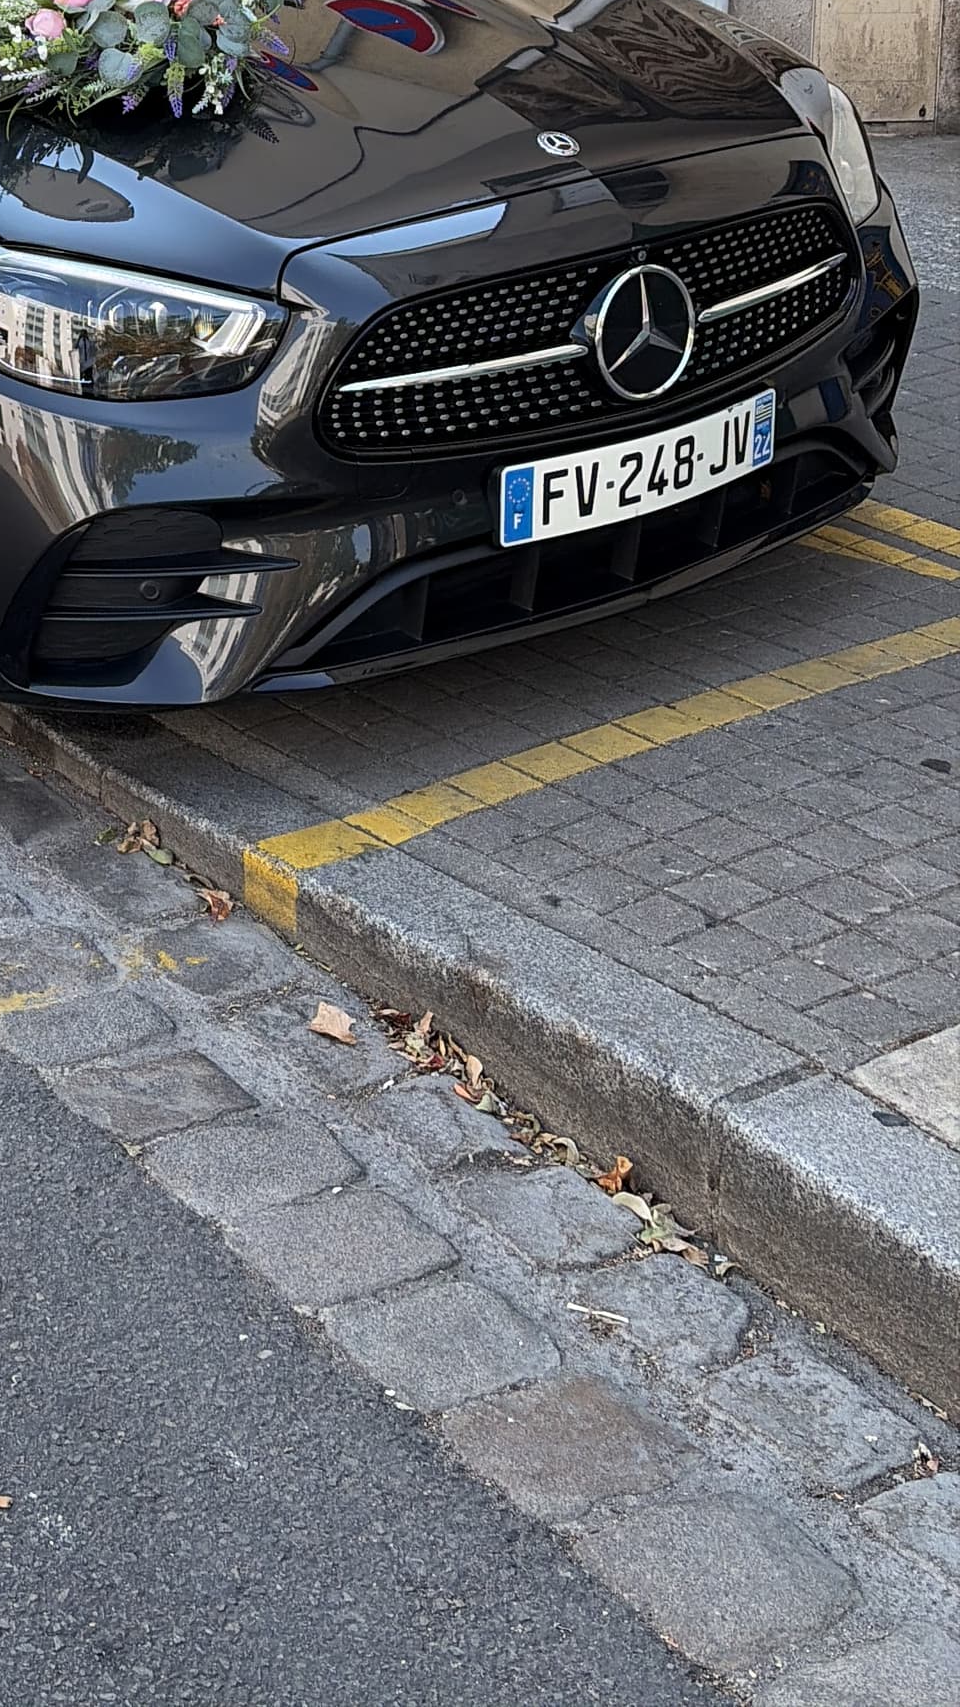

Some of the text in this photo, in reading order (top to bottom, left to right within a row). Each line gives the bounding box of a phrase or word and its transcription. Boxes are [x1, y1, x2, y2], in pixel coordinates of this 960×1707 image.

[753, 431, 771, 460] 22
[542, 410, 751, 525] FV-248-JV
[513, 512, 522, 530] F
